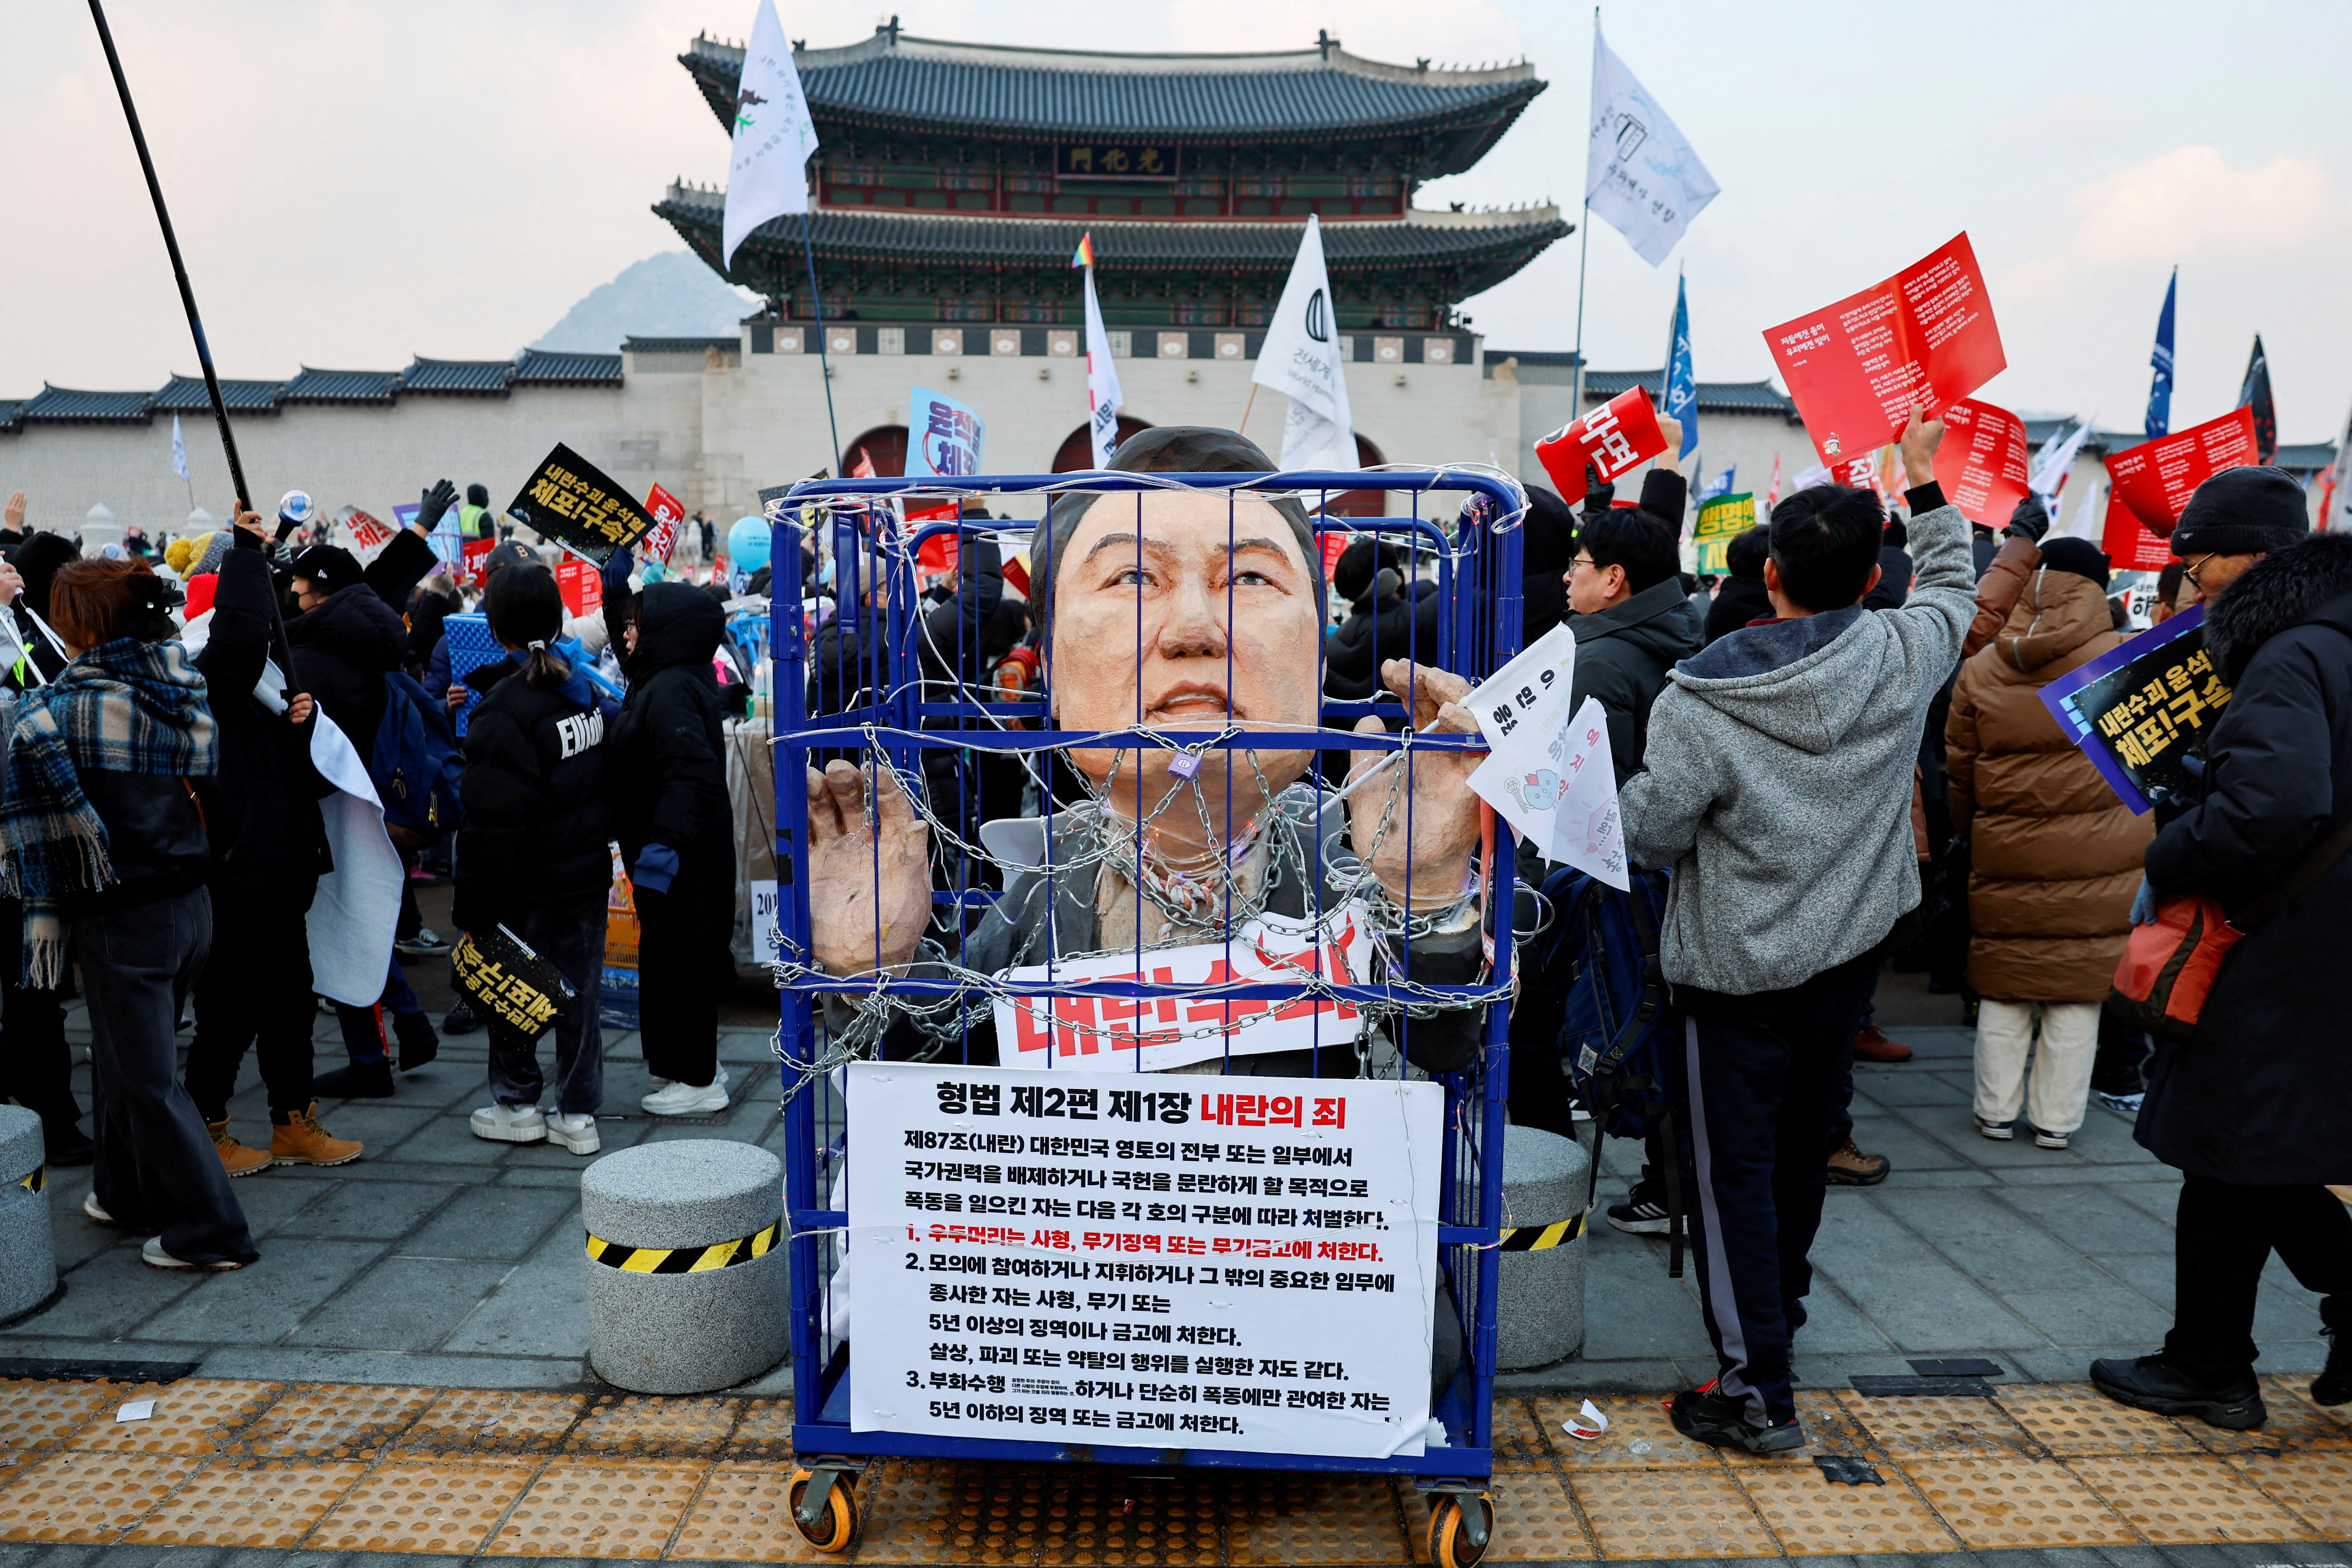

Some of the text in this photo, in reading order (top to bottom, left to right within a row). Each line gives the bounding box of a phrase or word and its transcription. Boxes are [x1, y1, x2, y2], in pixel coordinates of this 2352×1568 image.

[1780, 322, 1826, 347] 저들에겐 총이
[1785, 333, 1831, 358] 우리에겐 빛이
[1580, 402, 1639, 477] 파면
[545, 464, 607, 505] 내란수괴
[601, 497, 647, 533] 윤석열
[2099, 648, 2214, 737] 내란수괴 윤석
[482, 986, 540, 1035] 내란수괴
[937, 1081, 1345, 1129] 형법 제2편 제1장 내란의 죄
[904, 1129, 1352, 1167] 제87조(내란) 대한민국 영토의 전부 또는 일부에서
[905, 1160, 1368, 1197] 국가권력을 배제하거나 국헌을 문란하게 할 목적으로
[905, 1190, 1388, 1231] 폭동을 일으킨 자는 다음 각 호의 구분에 따라 처벌한다.
[905, 1223, 1383, 1262] 1. 우두머리는 사형, 무기징역 또는 무기금고에 처한다.
[905, 1252, 1394, 1292] 2. 모의에 참여하거나 지휘하거나 그 밖의 중요한 임무에
[929, 1283, 1170, 1313] 종사한 자는 사형, 무기 또는
[929, 1313, 1241, 1346] 5년 이상의 징역이나 금고에 처한다.
[929, 1343, 1348, 1381] 살상, 파괴 또는 약탈의 행위를 실행한 자도 같다.
[906, 1370, 1005, 1393] 3. 부화수행
[1075, 1379, 1389, 1411] 하거나 단순히 폭동에만 관여한 자는
[930, 1401, 1244, 1434] 5년 이하의 징역 또는 금고에 처한다.
